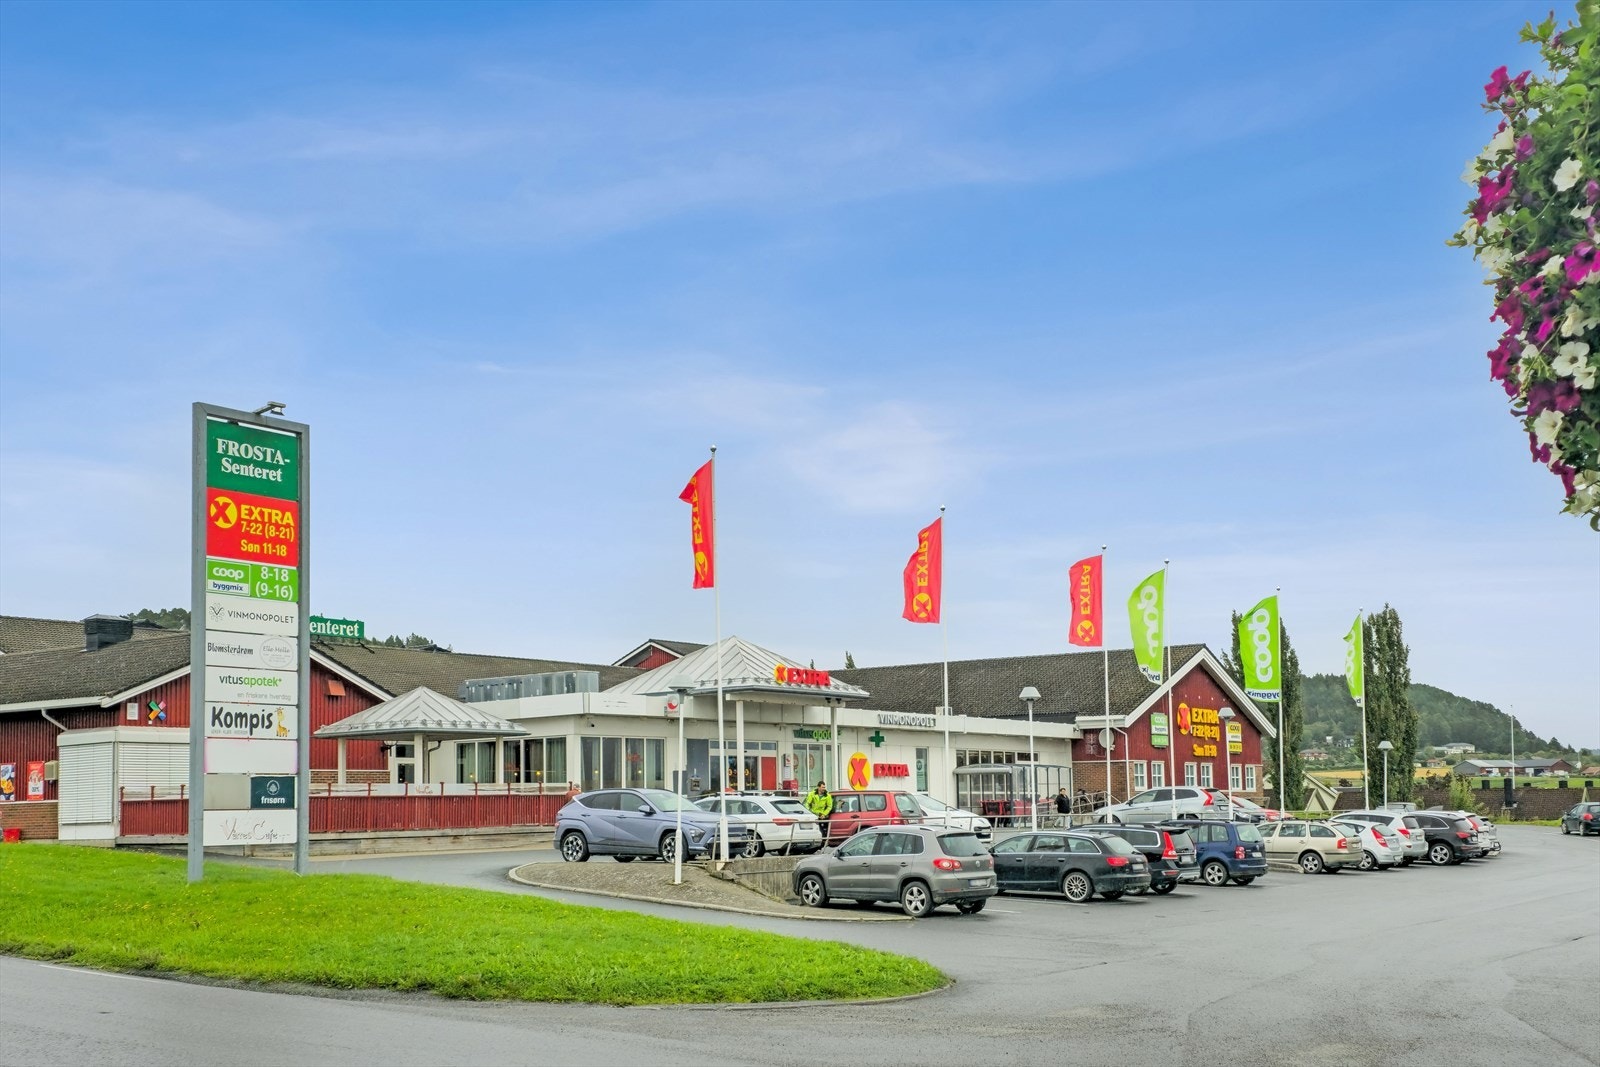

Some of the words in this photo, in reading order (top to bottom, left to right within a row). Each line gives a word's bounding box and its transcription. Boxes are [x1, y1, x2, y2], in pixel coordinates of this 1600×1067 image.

[216, 438, 291, 465] FROSTA-
[221, 457, 283, 482] Senteret
[241, 504, 294, 526] EXTRA
[241, 521, 262, 535] 7-22
[264, 523, 294, 542] (8-21)
[240, 539, 260, 553] Søn
[262, 542, 287, 556] 11-18
[212, 567, 244, 580] coop
[260, 566, 289, 582] 8-18
[212, 582, 244, 591] byggmix
[255, 581, 293, 600] (9-16)
[227, 610, 294, 624] VINMONOPOLET
[309, 620, 360, 637] enteret
[787, 668, 831, 686] EXTRA
[211, 706, 274, 736] Kompis
[878, 714, 936, 727] VINMONOPOLET
[1192, 707, 1220, 724] EXTRA
[873, 763, 909, 777] EXTRA
